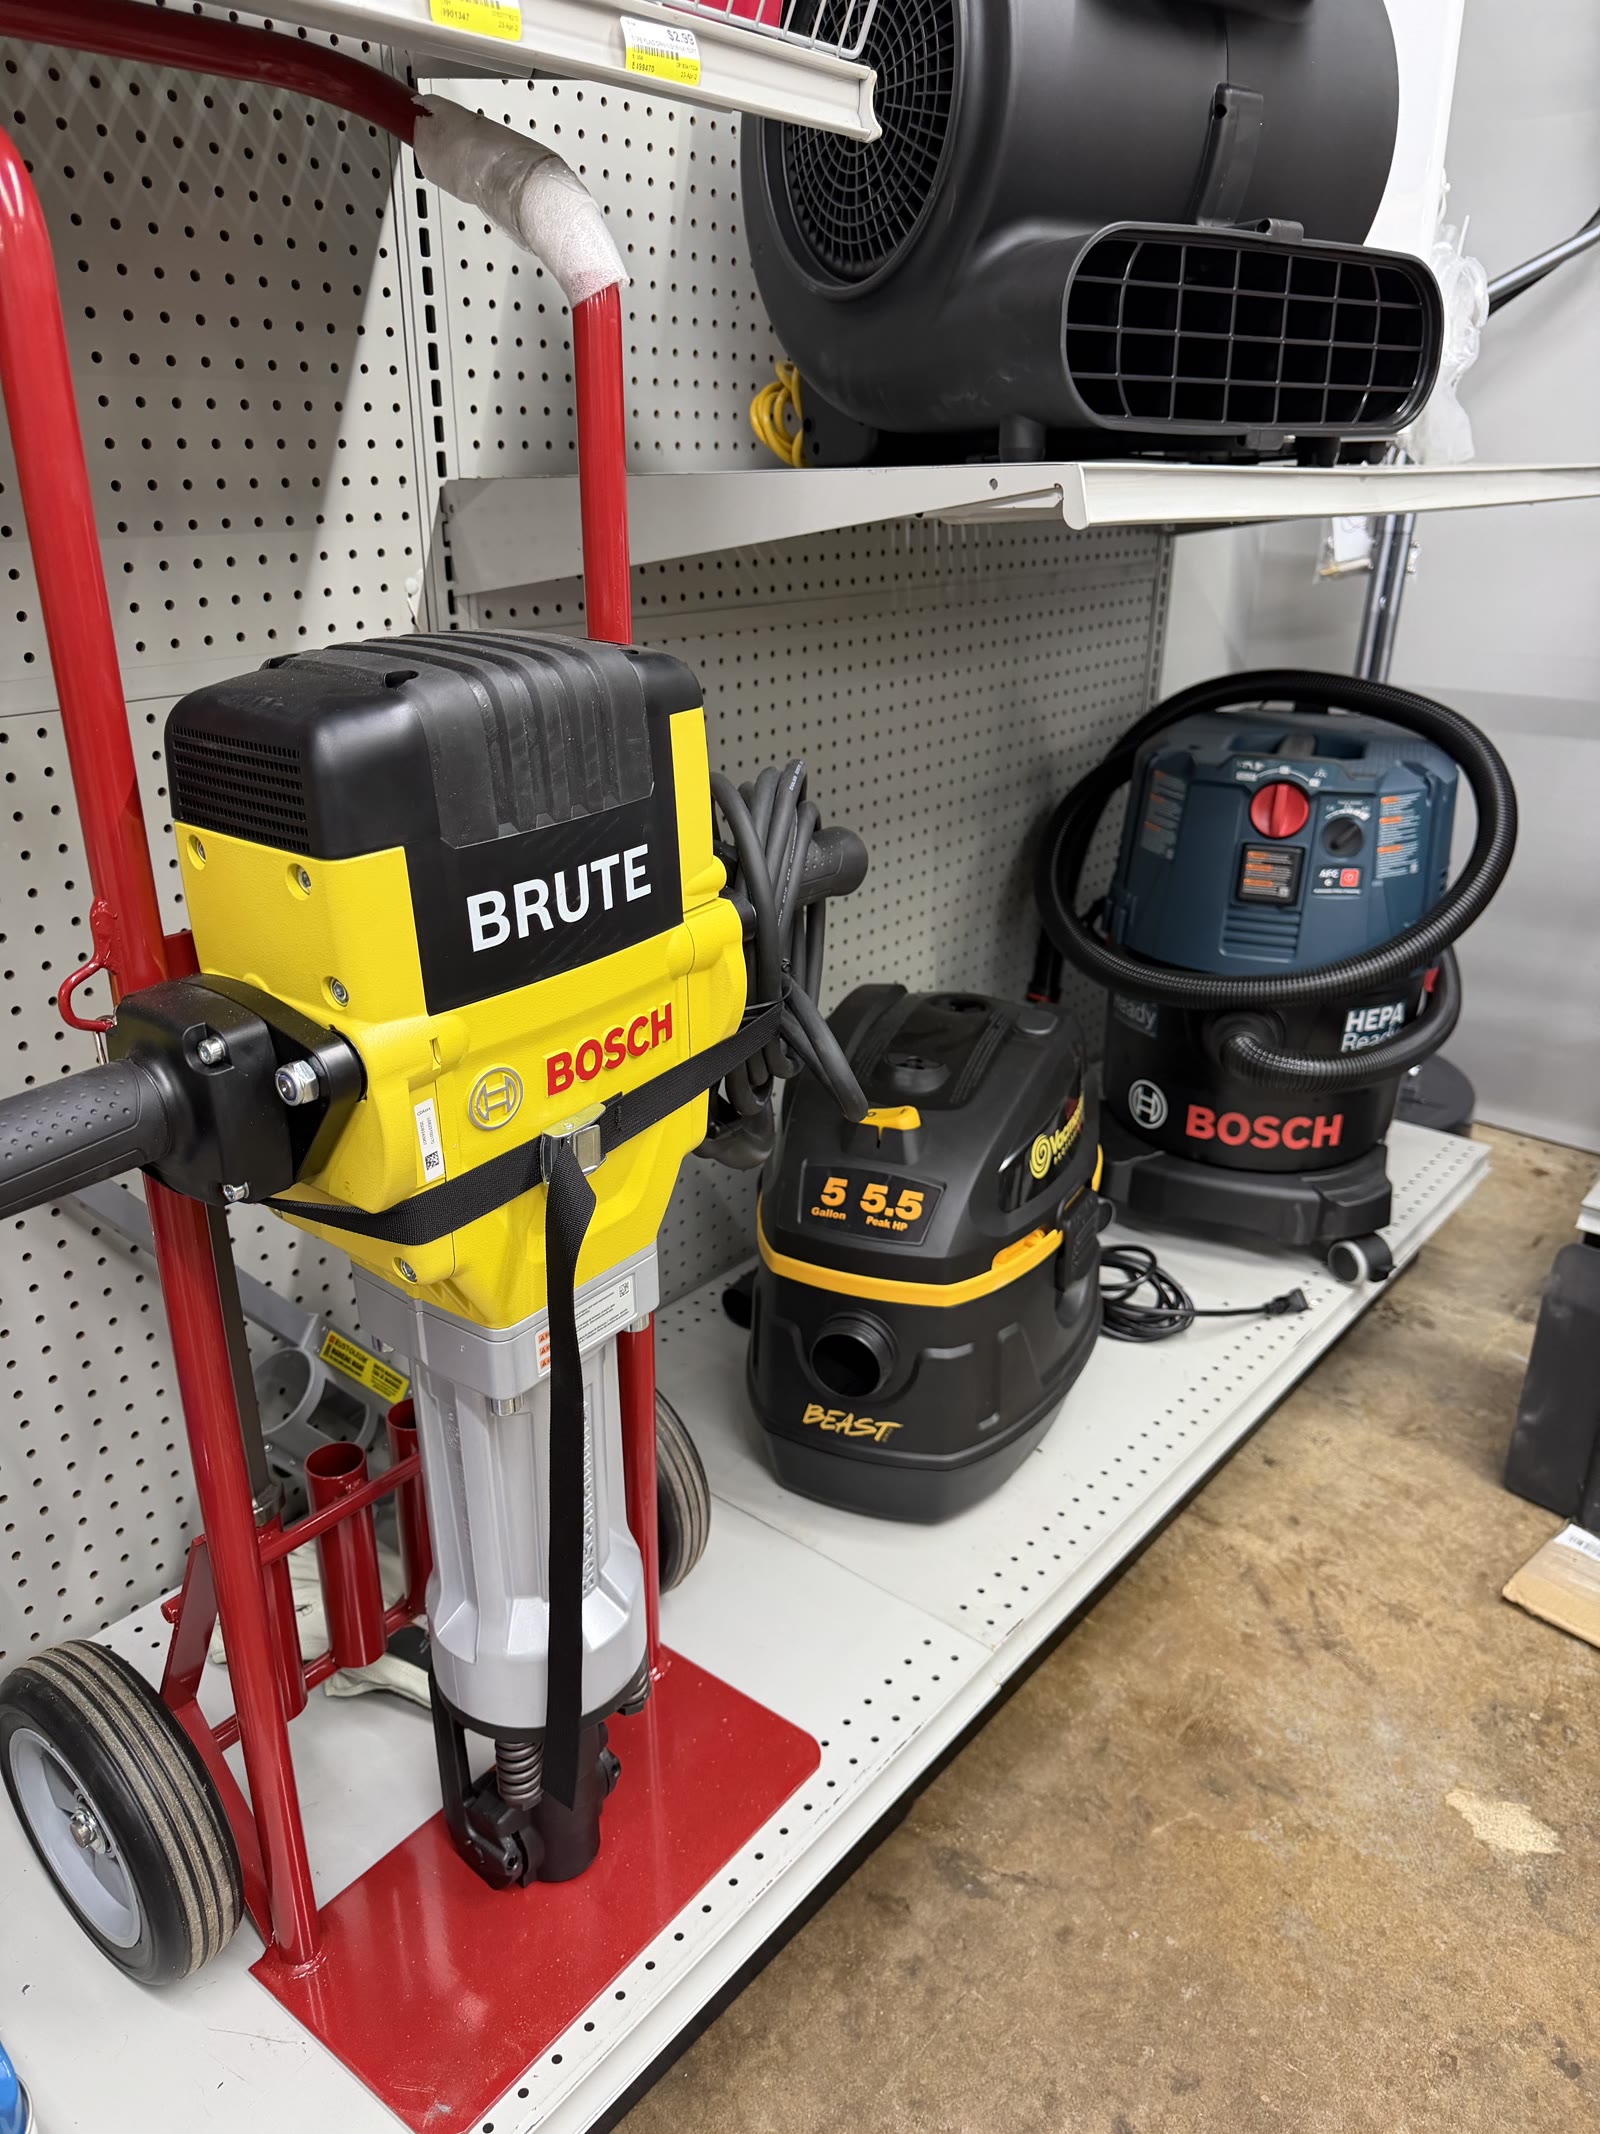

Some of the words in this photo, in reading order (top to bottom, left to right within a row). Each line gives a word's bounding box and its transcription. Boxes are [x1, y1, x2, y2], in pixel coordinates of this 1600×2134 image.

[666, 29, 695, 46] $2.99
[467, 844, 651, 952] BRUTE
[1345, 1002, 1406, 1033] HEPA
[547, 1001, 673, 1097] BOSCH
[1186, 1104, 1343, 1150] BOSCH
[811, 1206, 847, 1221] Gallon
[820, 1176, 848, 1207] 5
[860, 1183, 925, 1221] 5.5
[865, 1216, 891, 1230] Peak
[892, 1220, 909, 1232] HP
[802, 1403, 903, 1442] BEAST
